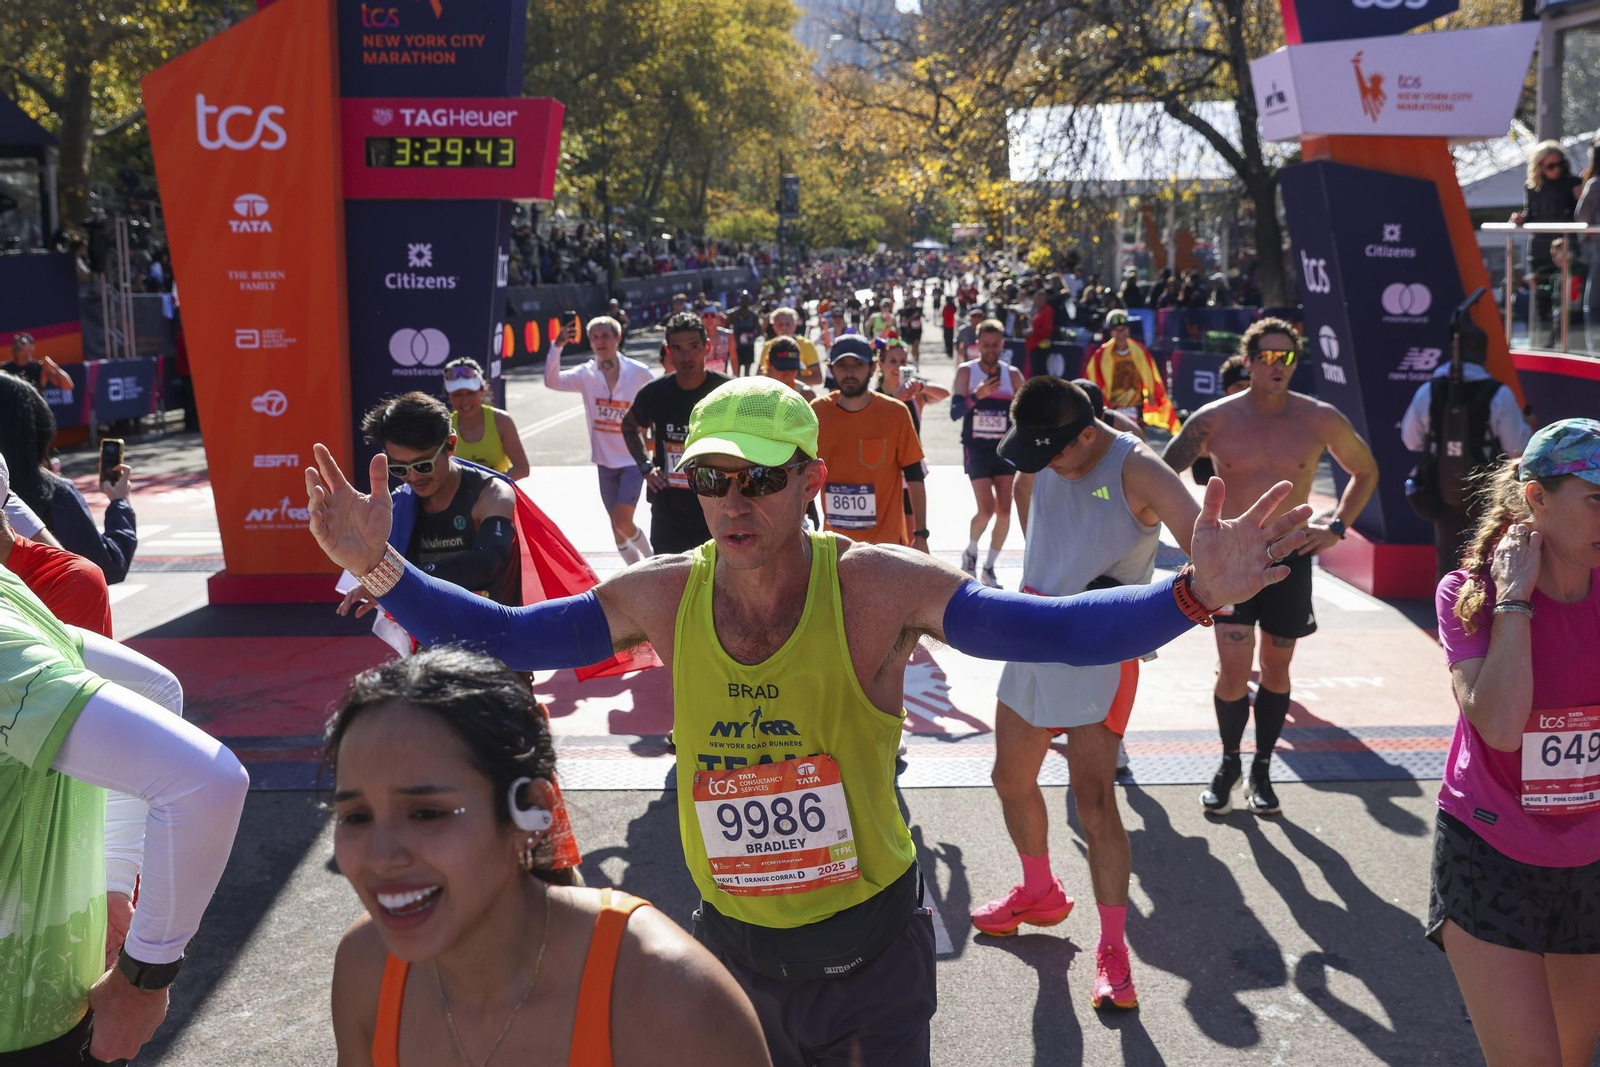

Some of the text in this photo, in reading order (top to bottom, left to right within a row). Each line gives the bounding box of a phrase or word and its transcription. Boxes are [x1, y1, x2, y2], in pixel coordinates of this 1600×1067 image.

[361, 3, 400, 28] tcs
[362, 35, 485, 48] NEW YORK CITY
[363, 52, 456, 65] MARATHON
[1396, 92, 1421, 101] NEW
[1423, 92, 1449, 101] YORK
[1396, 103, 1455, 112] MARATHON
[195, 93, 287, 151] tcs
[228, 220, 273, 233] TATA
[1365, 244, 1418, 258] Citizens
[1300, 249, 1331, 294] tcs
[384, 273, 456, 289] Citizens
[391, 367, 446, 376] mastercar
[253, 455, 299, 468] ESPN
[833, 495, 867, 510] 8610
[728, 683, 779, 700] BRAD
[1539, 714, 1566, 729] tcs
[709, 741, 803, 752] NEW YORK ROAD RUNNERS
[1541, 731, 1600, 767] 649
[738, 773, 758, 782] TATA
[740, 777, 784, 788] CONSULTANCY
[796, 776, 821, 786] TATA
[708, 777, 738, 797] tcs
[741, 785, 769, 794] SERVICES
[1543, 796, 1549, 804] 1
[1589, 792, 1595, 800] B
[716, 792, 827, 842] 9986
[746, 838, 806, 854] BRADLEY
[834, 846, 853, 856] TFK
[818, 861, 846, 876] 2025
[735, 875, 740, 885] 1
[744, 876, 770, 884] ORANGE
[771, 873, 798, 882] CORRAL
[798, 871, 806, 881] D
